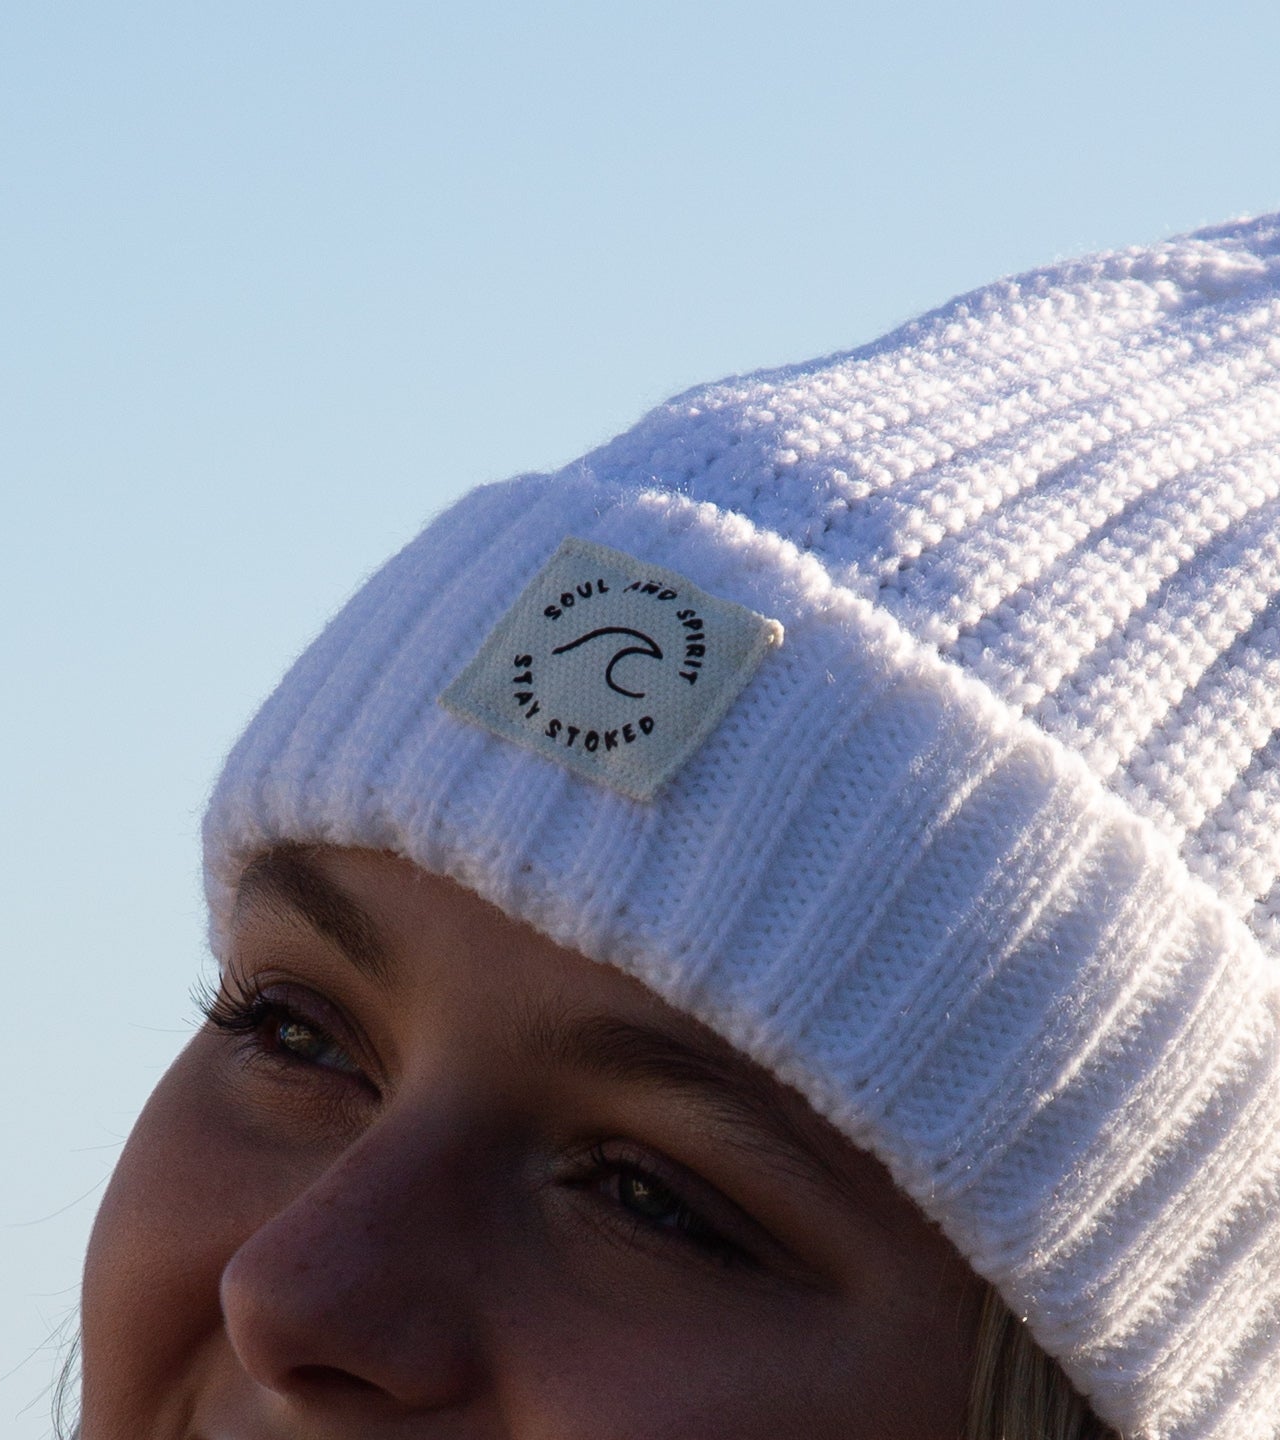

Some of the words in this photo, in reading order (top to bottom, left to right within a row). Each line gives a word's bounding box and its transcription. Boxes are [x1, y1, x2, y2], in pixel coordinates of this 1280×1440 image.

[544, 579, 610, 620] SOUL
[624, 580, 677, 600] AND
[677, 609, 705, 685] SPIRIT
[513, 654, 540, 719] STAY
[545, 716, 654, 752] STOKED
